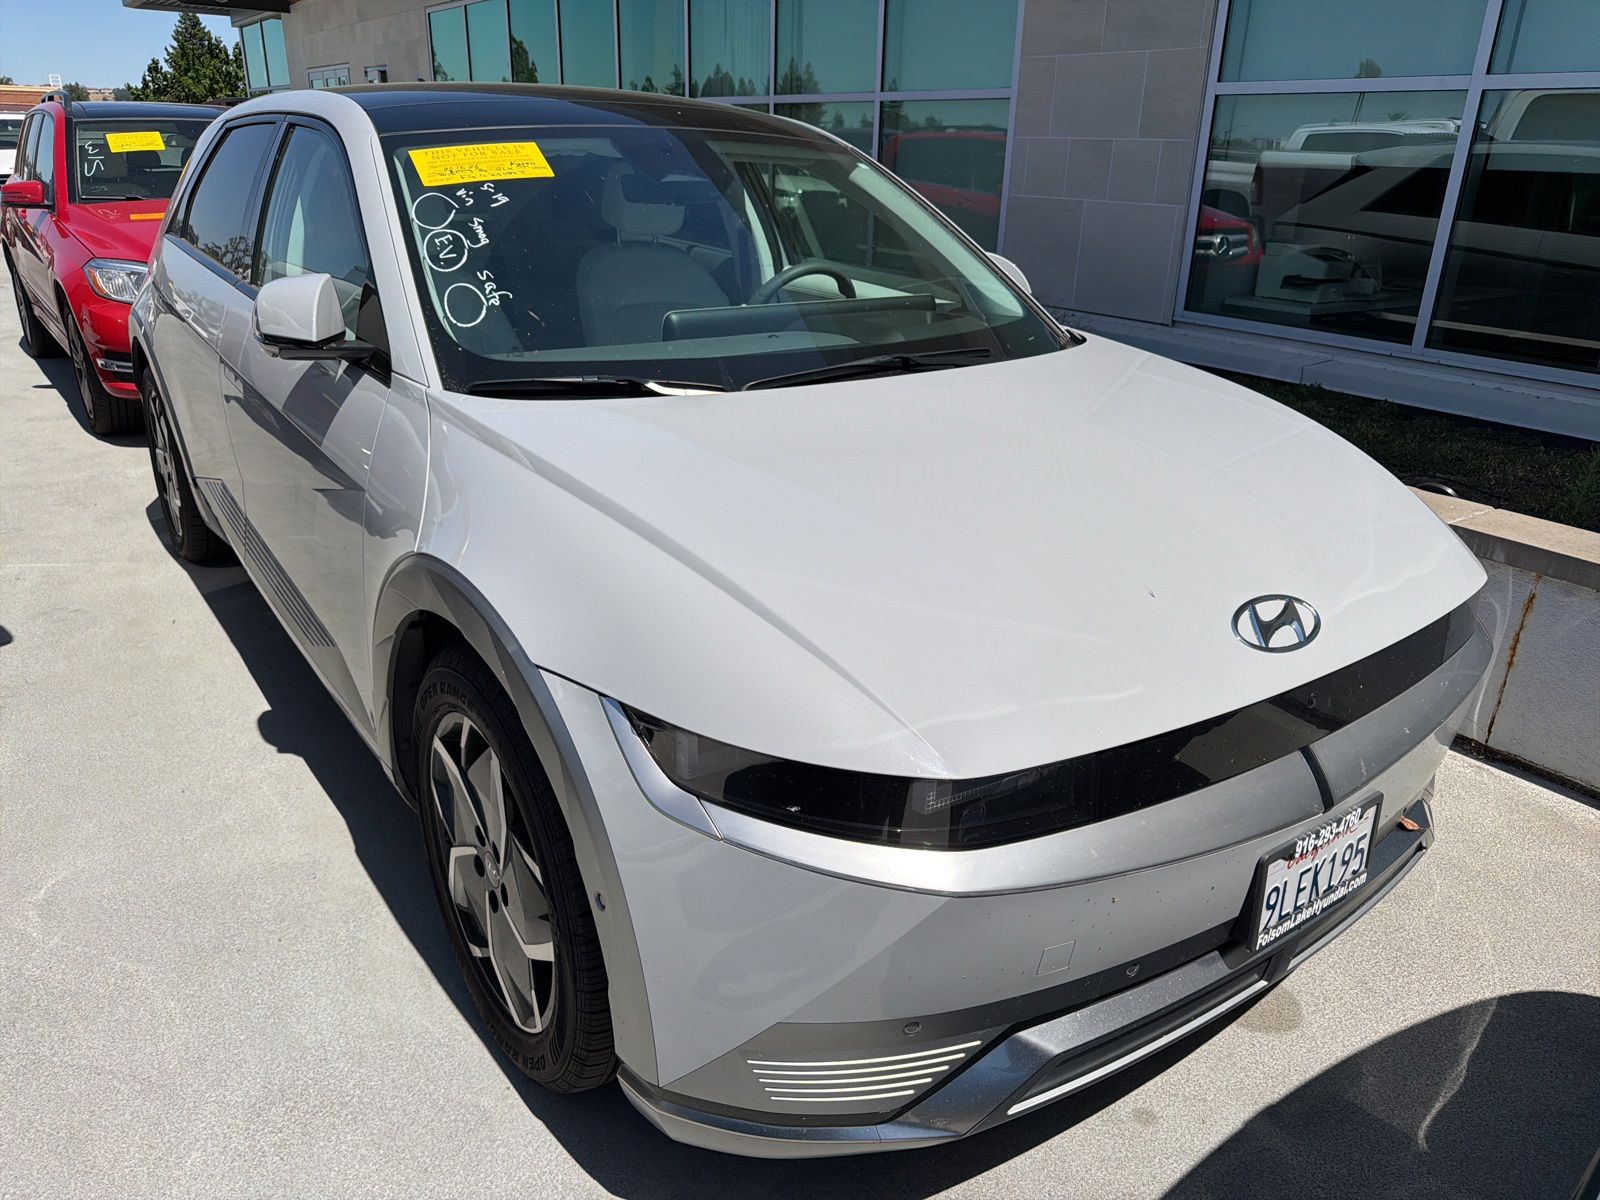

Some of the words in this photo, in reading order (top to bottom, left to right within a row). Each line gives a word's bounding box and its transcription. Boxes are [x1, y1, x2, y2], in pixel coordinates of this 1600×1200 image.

[457, 145, 508, 153] VEHICLE
[1295, 807, 1362, 858] 916-293-4760
[1256, 872, 1367, 951] FolsomLakeHyundai.com
[1261, 833, 1368, 932] 9LEK195
